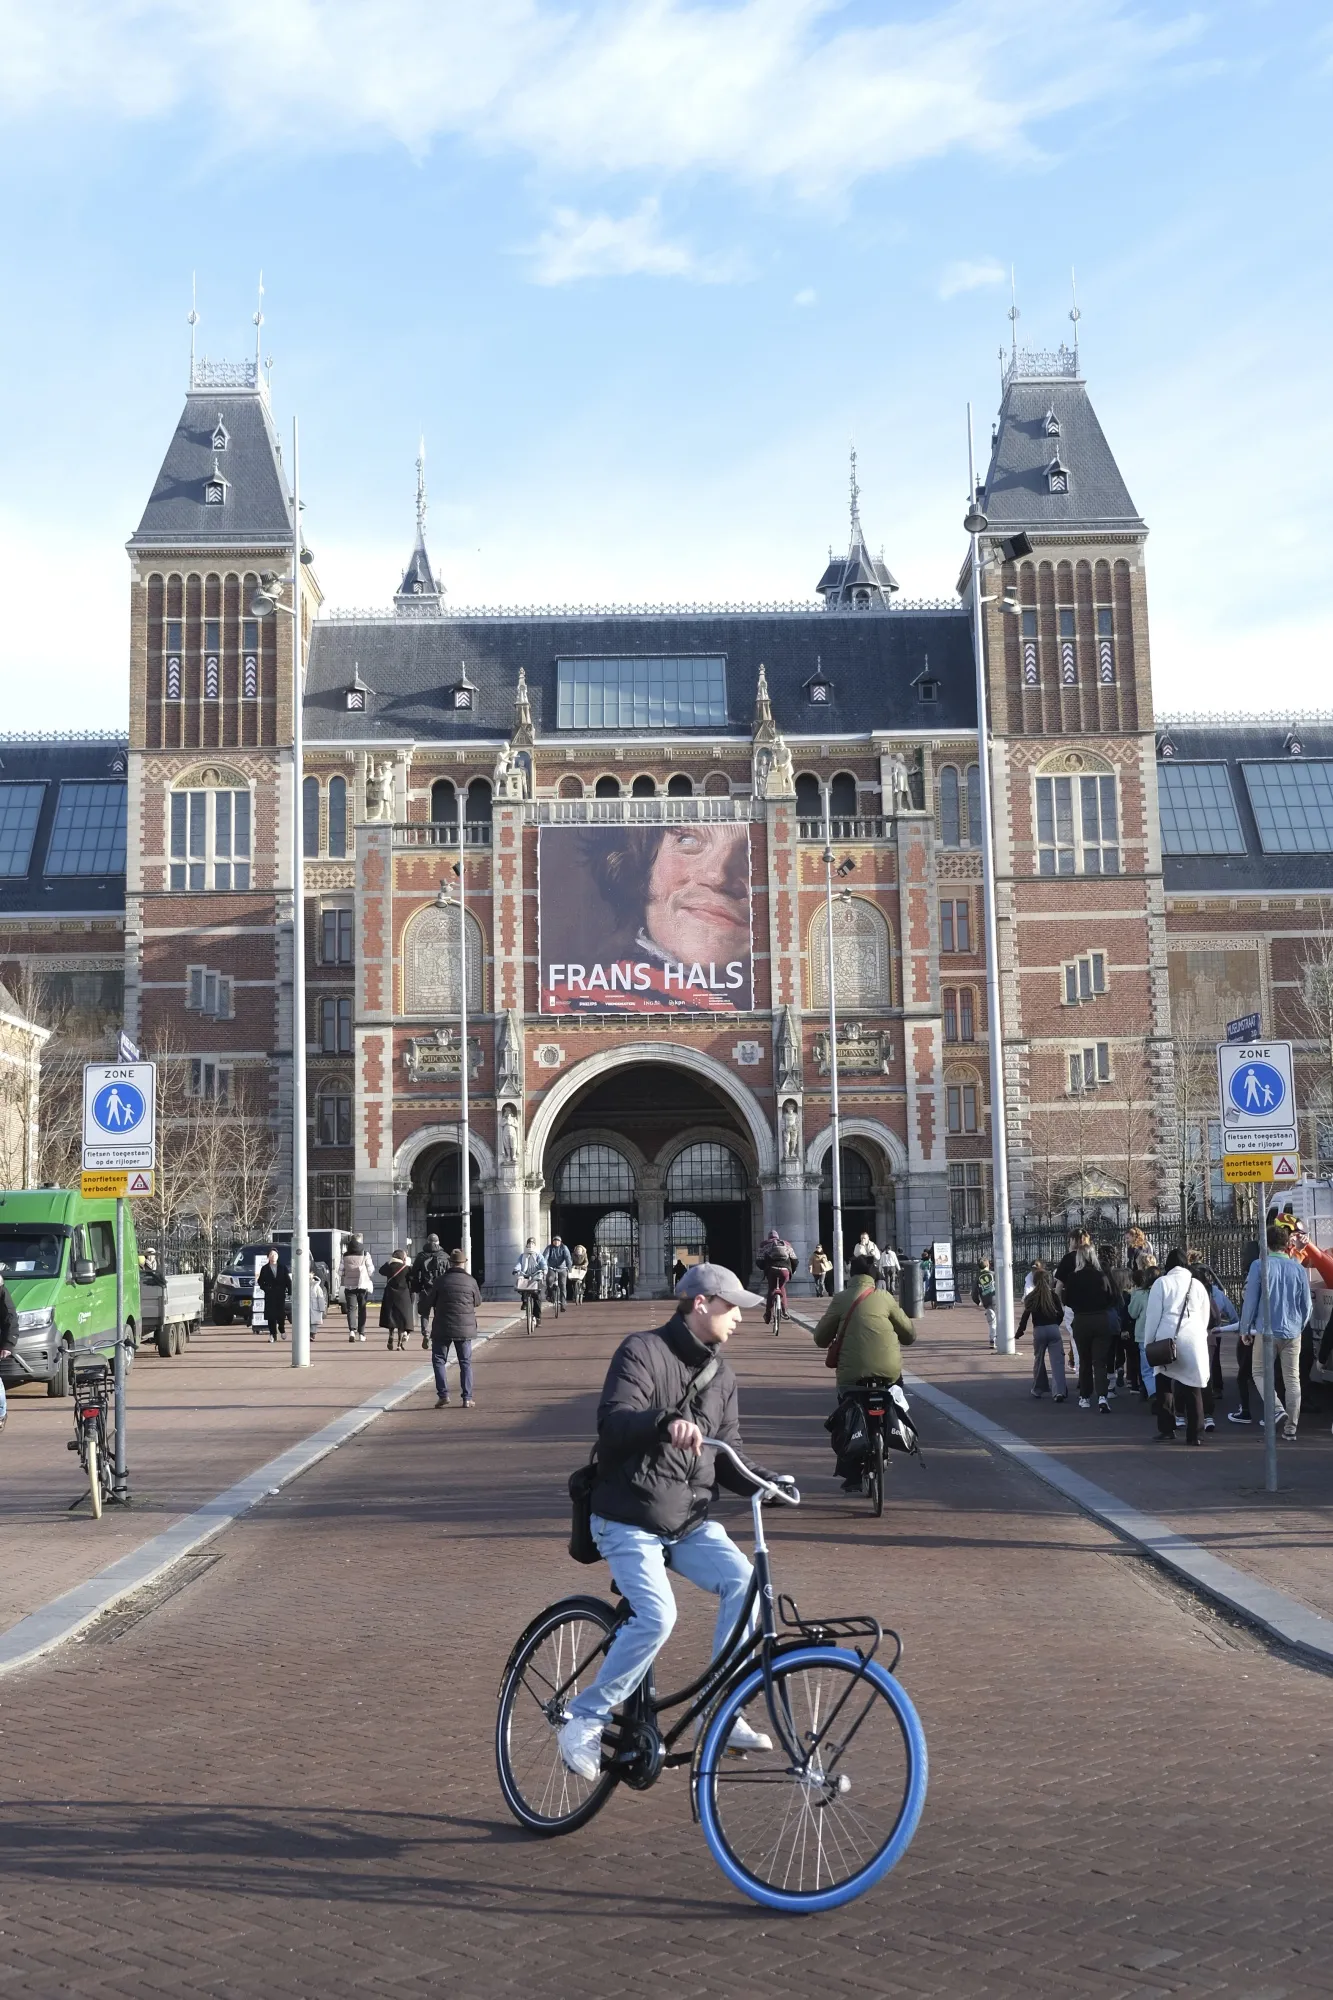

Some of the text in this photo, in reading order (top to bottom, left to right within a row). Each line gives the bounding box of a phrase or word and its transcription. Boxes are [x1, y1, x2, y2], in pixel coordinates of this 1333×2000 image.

[549, 961, 744, 991] FRANS HALS
[1239, 1049, 1271, 1059] ZONE
[104, 1070, 135, 1079] ZONE
[1254, 1132, 1293, 1142] toegestaan
[1258, 1140, 1284, 1151] rijloper
[87, 1149, 150, 1158] fietsen toegestaan
[115, 1157, 140, 1167] rijloper
[1226, 1159, 1272, 1168] snorfietsers
[1226, 1169, 1262, 1178] verboden
[83, 1175, 128, 1183] snorfietsers
[83, 1185, 117, 1193] verboden
